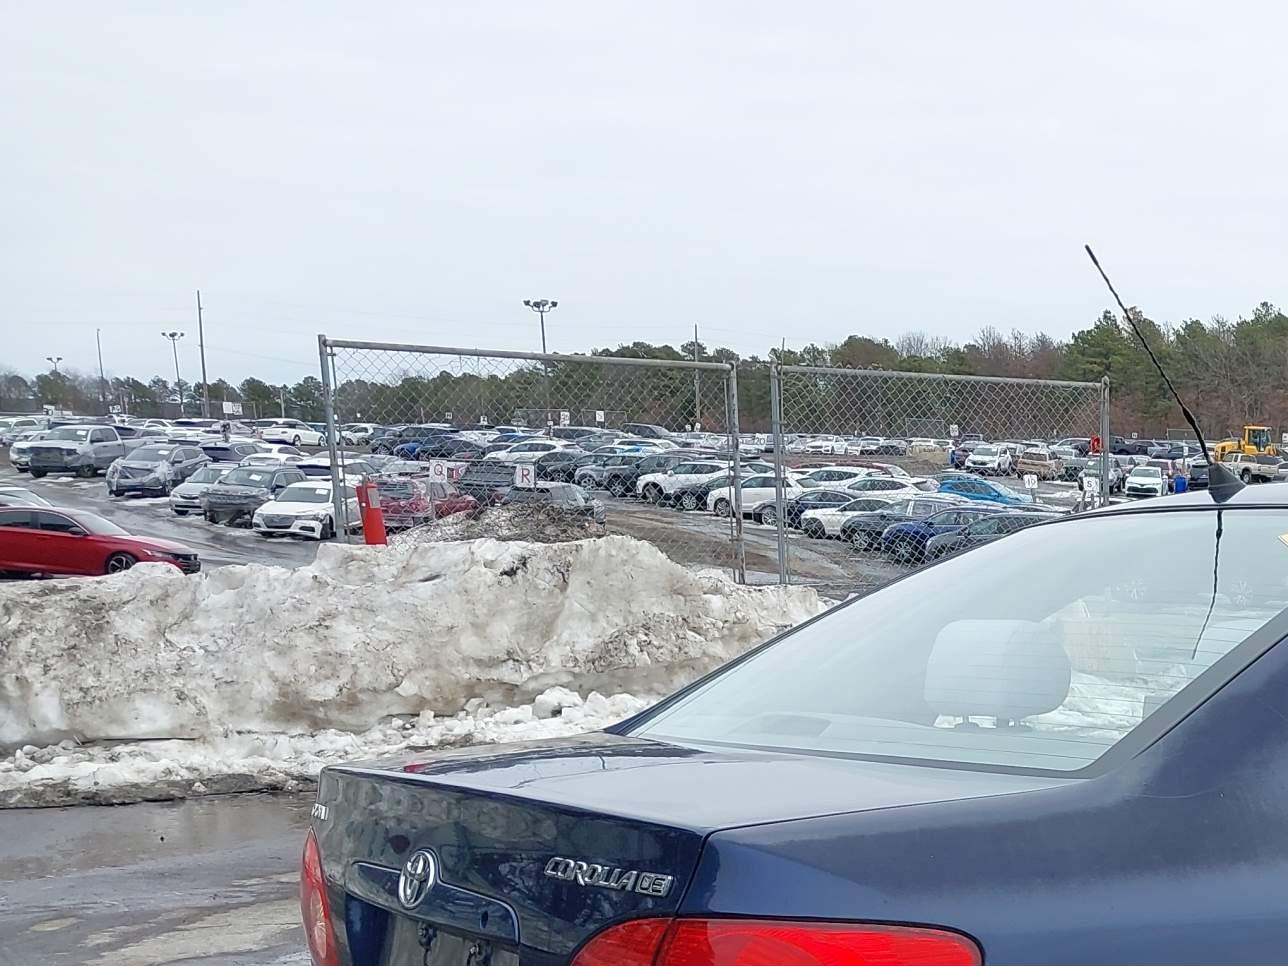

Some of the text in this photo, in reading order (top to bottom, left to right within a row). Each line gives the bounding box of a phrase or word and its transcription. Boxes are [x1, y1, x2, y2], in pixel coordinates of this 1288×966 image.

[434, 463, 445, 477] Q
[521, 467, 531, 483] R
[543, 856, 638, 892] COROLLA
